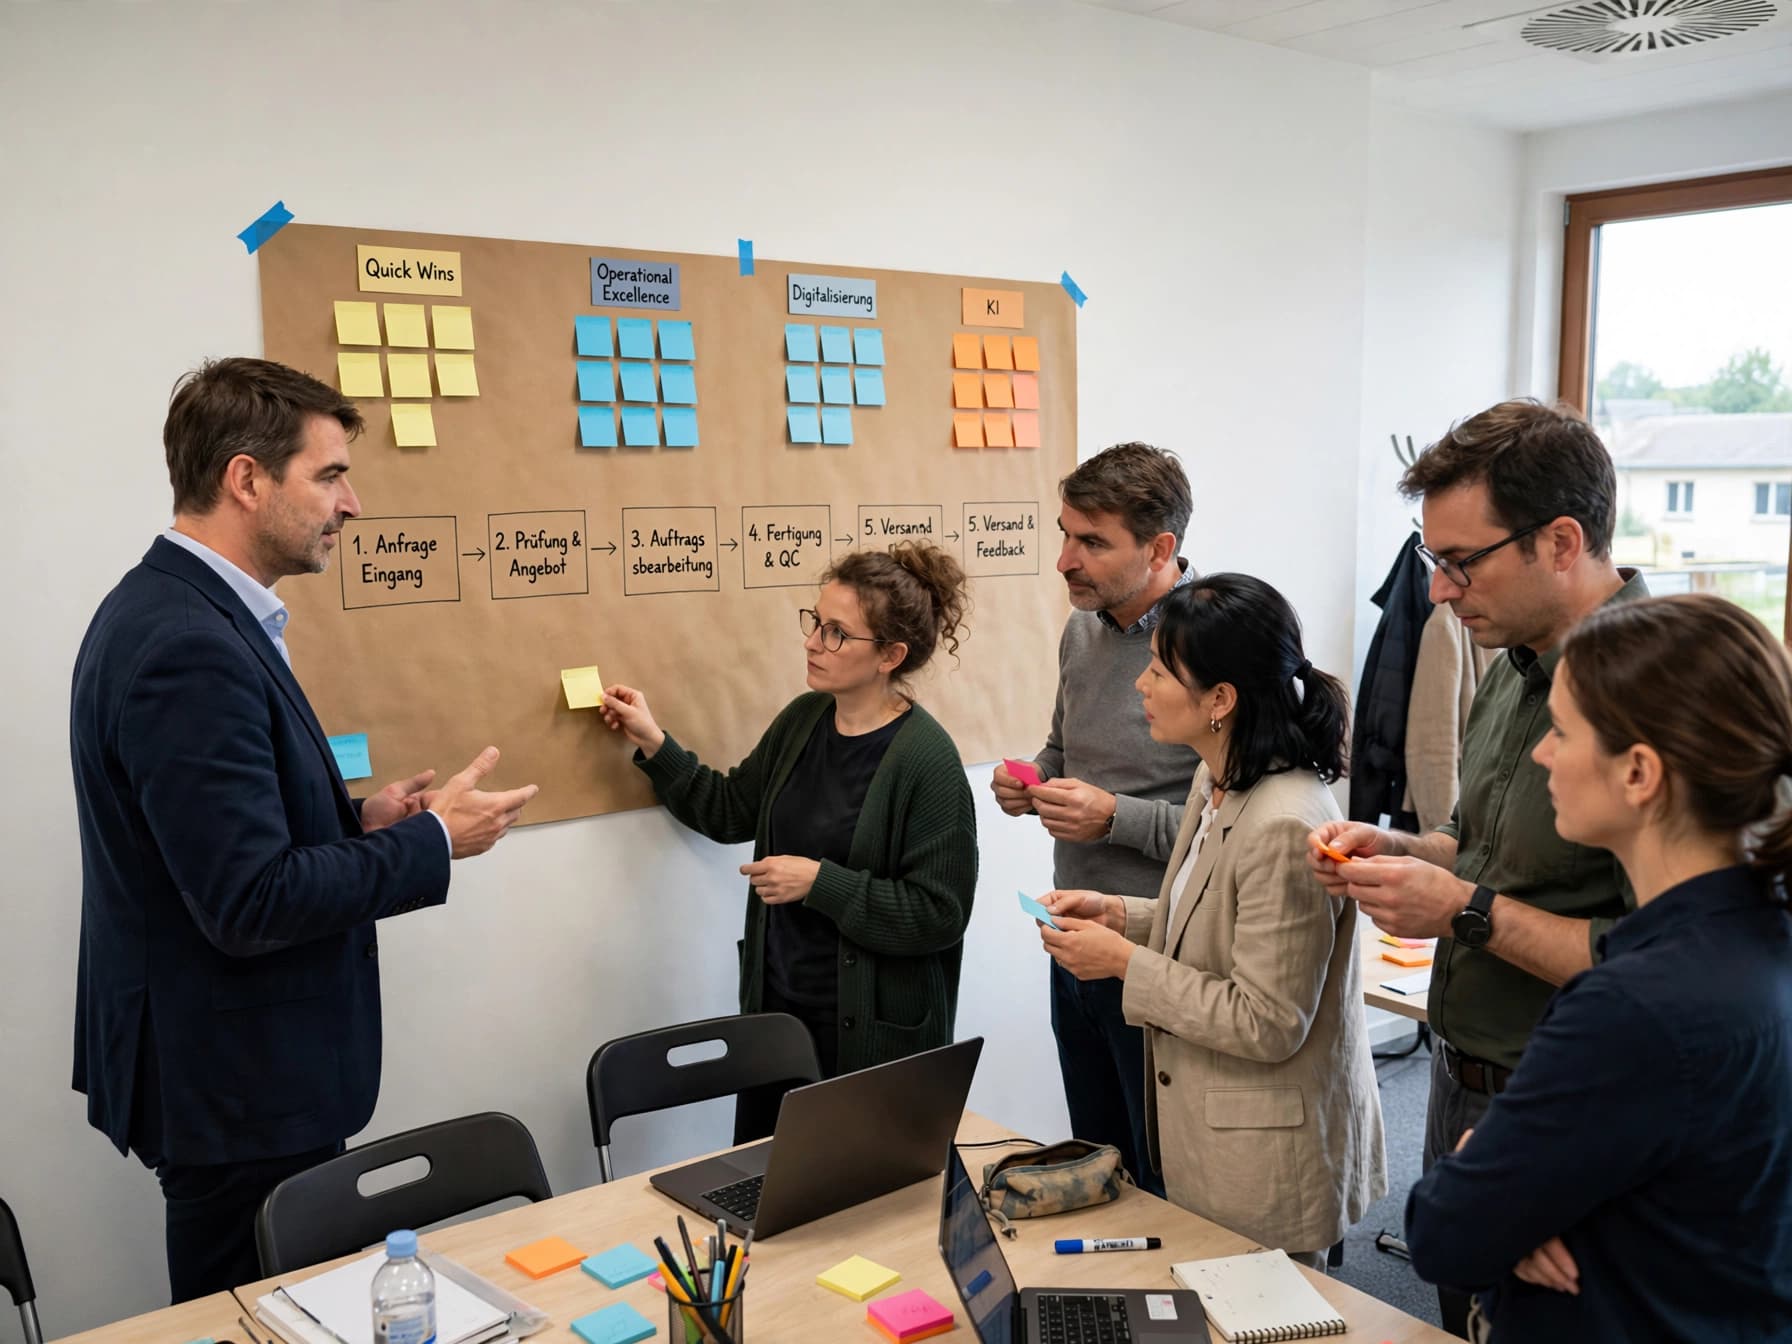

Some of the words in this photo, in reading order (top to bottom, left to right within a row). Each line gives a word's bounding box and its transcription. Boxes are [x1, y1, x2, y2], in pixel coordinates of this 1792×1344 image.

[366, 258, 412, 279] Quick
[417, 261, 454, 281] Wins
[597, 263, 672, 285] Operational
[602, 285, 669, 304] Excellence
[793, 284, 872, 312] Digitalisierung
[986, 299, 999, 315] KI
[865, 519, 876, 535] 5.
[969, 516, 979, 532] 5.
[984, 515, 1023, 531] Versand
[1027, 515, 1035, 530] &
[353, 535, 367, 555] 1.
[376, 533, 436, 559] Anfrage
[496, 532, 509, 550] 2.
[516, 530, 567, 555] Prüfung
[572, 530, 581, 546] &
[632, 530, 644, 547] 3.
[651, 528, 705, 552] Auftrags
[749, 524, 761, 541] 4.
[767, 524, 821, 547] Fertigung
[765, 552, 774, 567] &
[780, 549, 800, 567] QC
[977, 540, 1024, 557] Feedback
[362, 563, 422, 590] Eingang
[509, 557, 567, 584] Angebot
[633, 556, 712, 578] sbearbeitung
